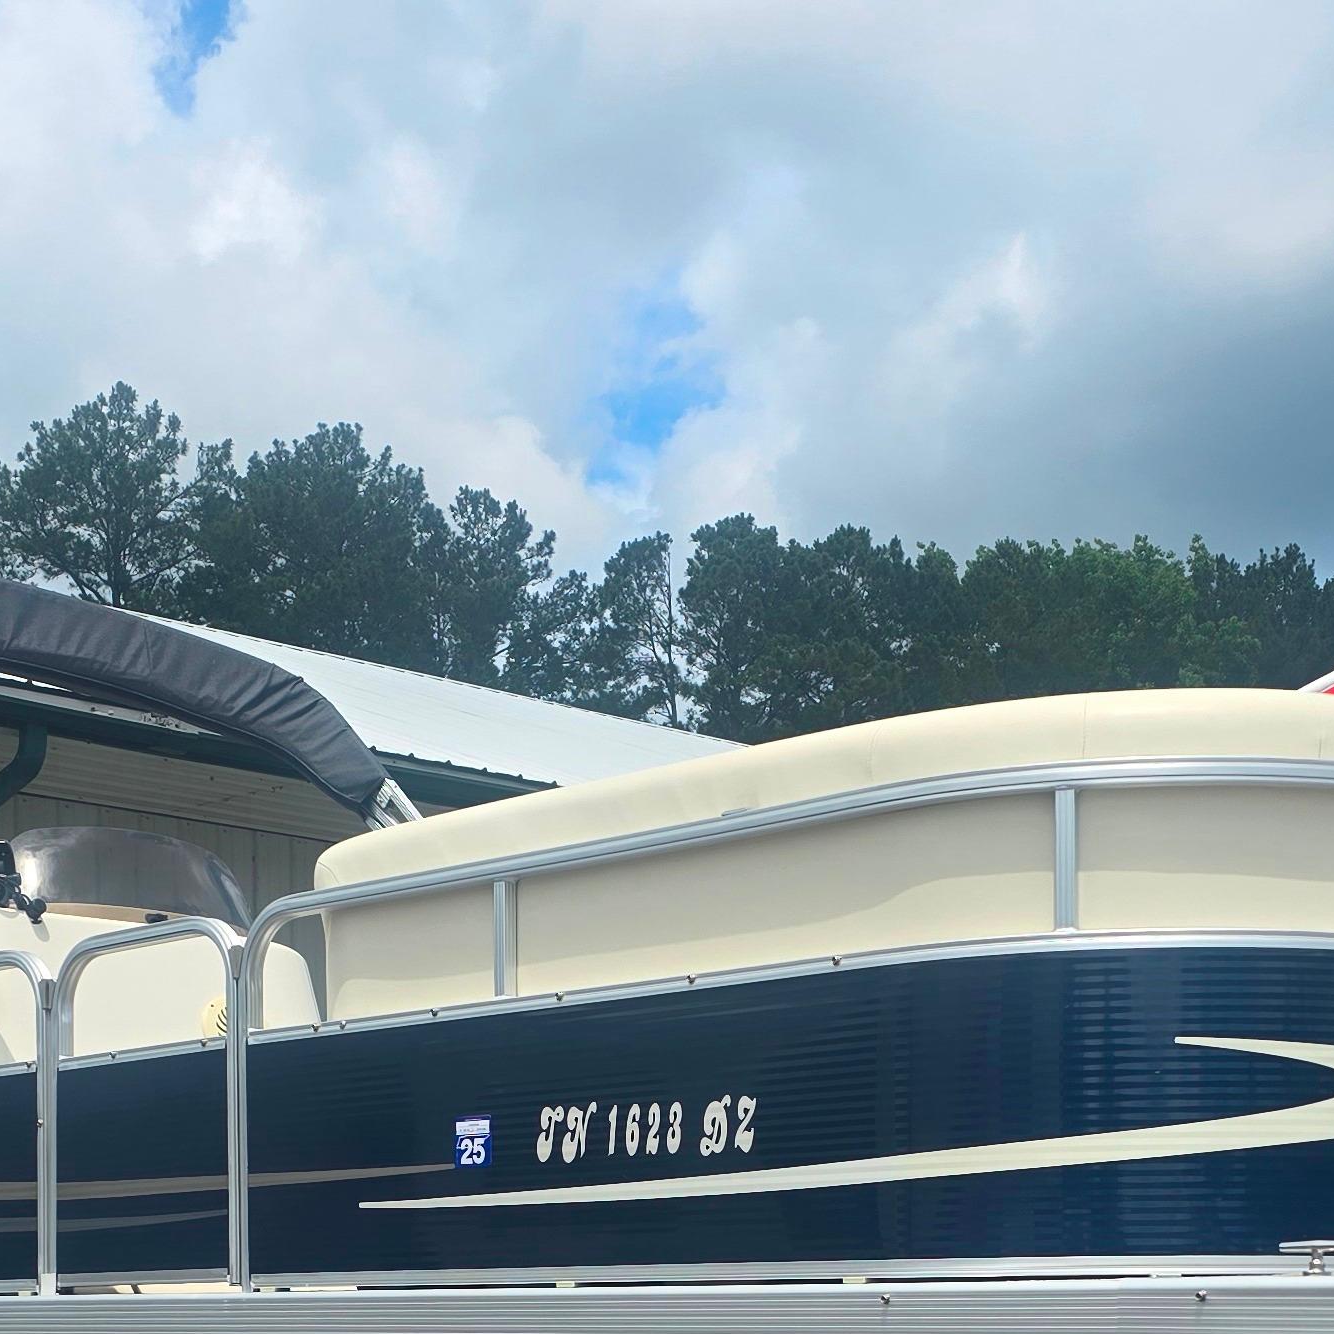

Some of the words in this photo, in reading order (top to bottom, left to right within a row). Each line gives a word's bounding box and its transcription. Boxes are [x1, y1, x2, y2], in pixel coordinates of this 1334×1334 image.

[460, 1138, 486, 1165] 25
[536, 1102, 597, 1164] TN
[608, 1101, 682, 1157] 1623
[700, 1094, 757, 1157] DZ
